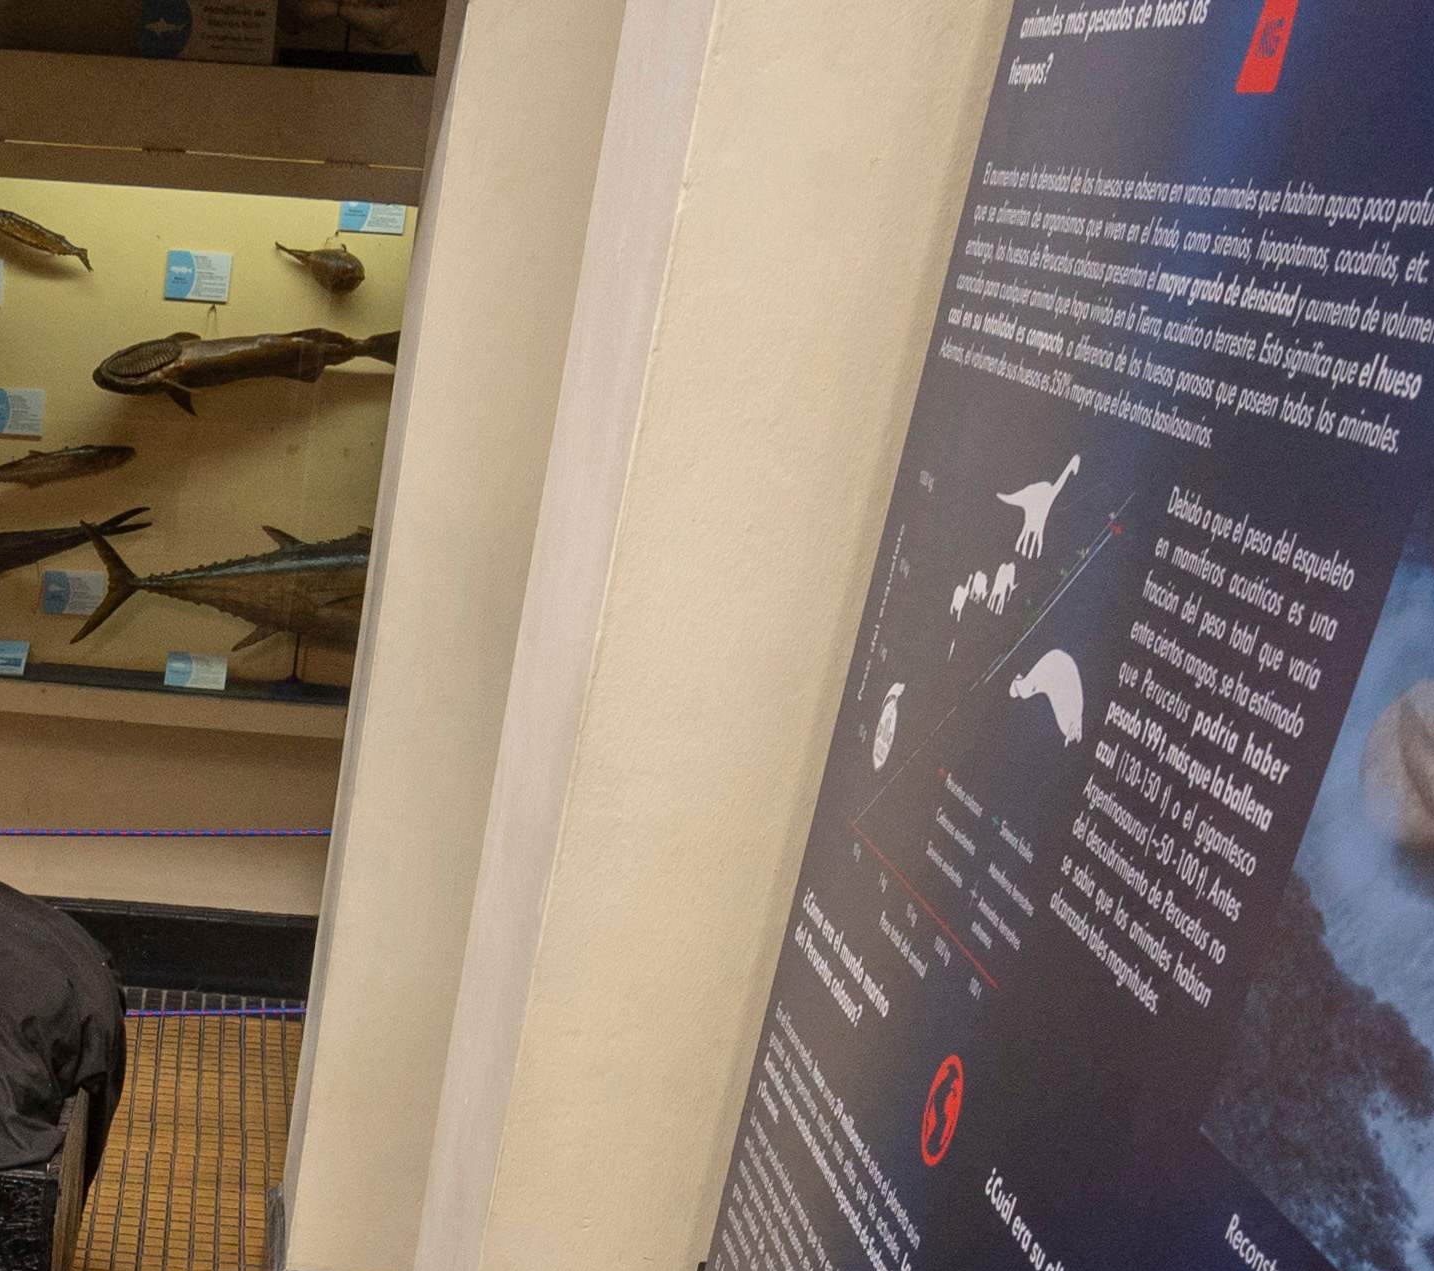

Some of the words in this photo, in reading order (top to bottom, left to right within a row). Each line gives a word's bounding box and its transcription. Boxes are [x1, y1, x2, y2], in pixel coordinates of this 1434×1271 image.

[1008, 52, 1054, 93] tiempos?
[1020, 4, 1065, 39] animales
[1063, 1, 1087, 35] más
[1085, 0, 1134, 42] pesados
[1135, 0, 1152, 29] de
[1103, 700, 1142, 739] pesado
[1139, 716, 1163, 752] 199
[1164, 742, 1191, 775] más
[1187, 758, 1212, 790] que
[1208, 763, 1225, 799] la
[1220, 772, 1273, 832] ballena
[1117, 660, 1139, 688] que
[1139, 667, 1191, 723] Perucetus
[1189, 709, 1239, 754] podría
[1241, 730, 1290, 785] haber
[983, 1165, 1018, 1226] ¿Cuál
[1009, 1213, 1034, 1254] era
[1027, 1240, 1047, 1271] su
